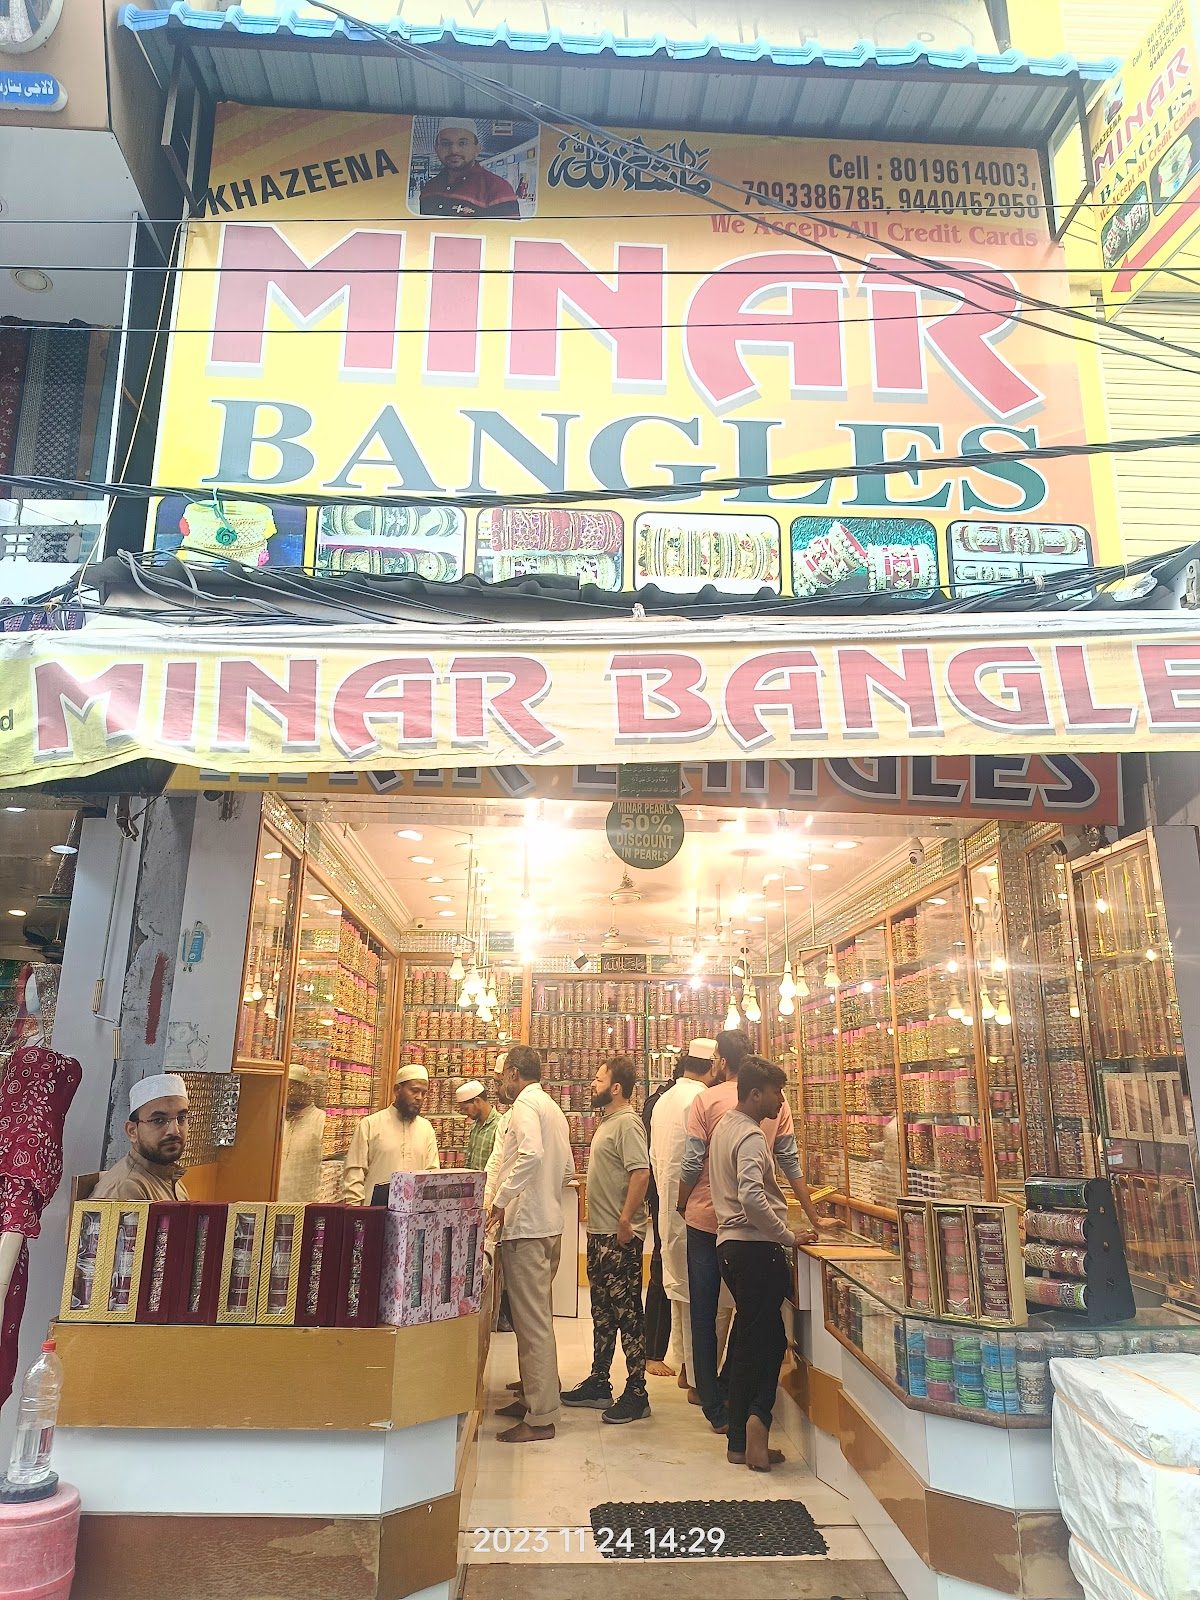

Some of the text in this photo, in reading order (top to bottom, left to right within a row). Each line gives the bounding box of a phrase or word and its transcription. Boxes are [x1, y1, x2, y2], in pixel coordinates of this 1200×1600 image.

[1092, 47, 1191, 184] MINAR
[1100, 81, 1194, 204] BANGLES
[207, 148, 400, 216] KHAZEENA
[827, 153, 869, 180] Cell
[889, 156, 1037, 188] 8019614003,
[742, 180, 1040, 219] 7093386785, 9440452958
[710, 213, 1038, 248] We Accept All Credit Cards
[206, 223, 1045, 418] MINAR
[202, 399, 1047, 513] BANGLES
[34, 656, 563, 758] MINAR
[617, 802, 675, 814] MINAR PEARLS
[620, 813, 672, 834] 50%
[616, 833, 675, 849] DISCOUNT
[621, 848, 669, 861] IN PEARLS
